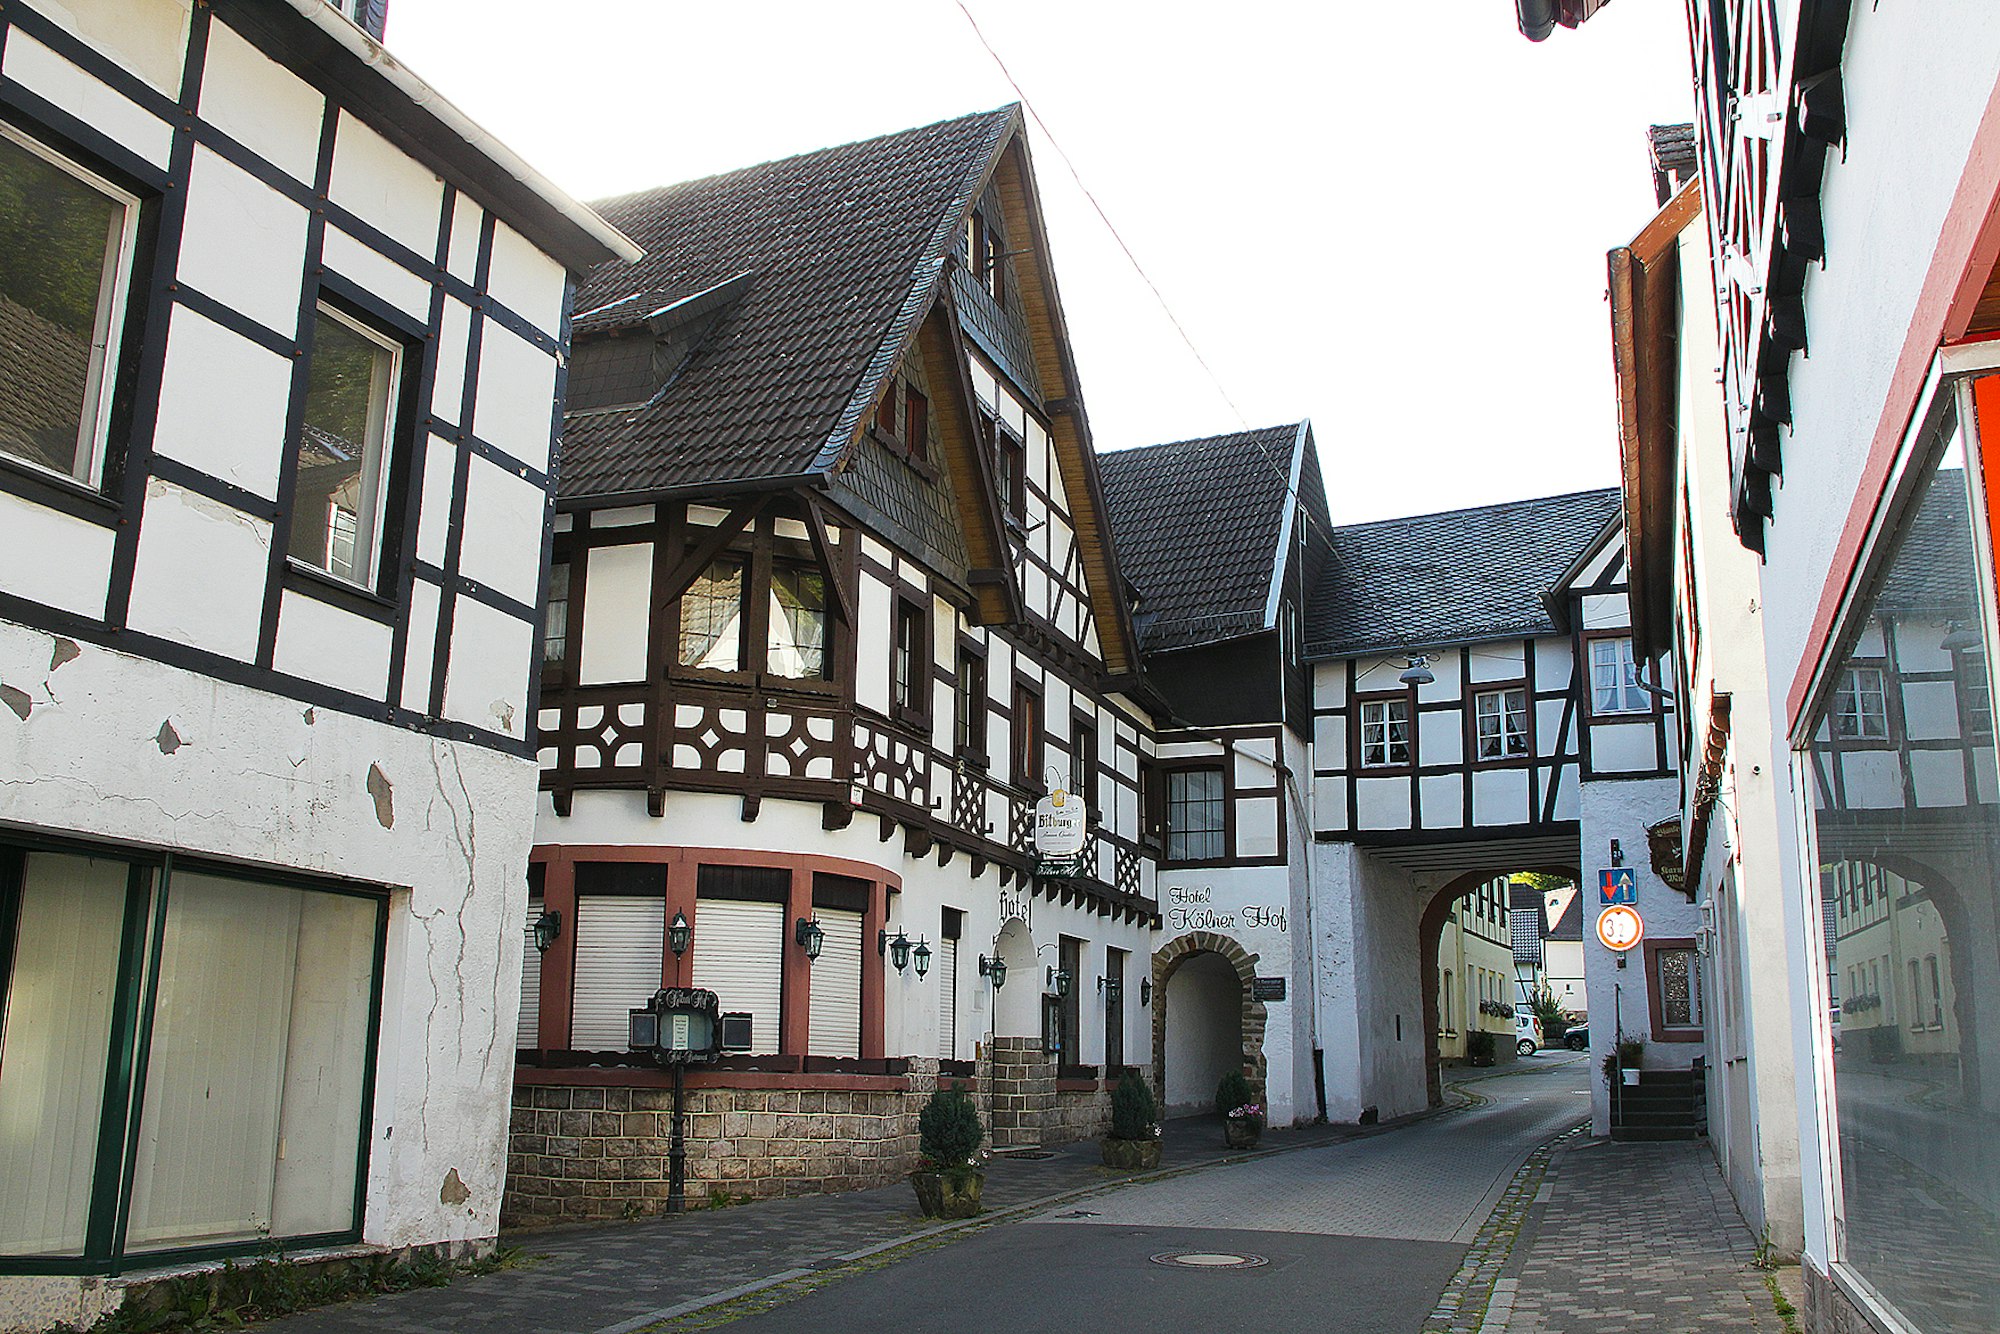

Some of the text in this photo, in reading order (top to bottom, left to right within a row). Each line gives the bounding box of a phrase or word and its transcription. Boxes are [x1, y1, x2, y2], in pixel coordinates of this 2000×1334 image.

[1169, 887, 1211, 905] Hotel
[999, 889, 1033, 934] Hotel
[1168, 905, 1288, 933] Kölner Hof
